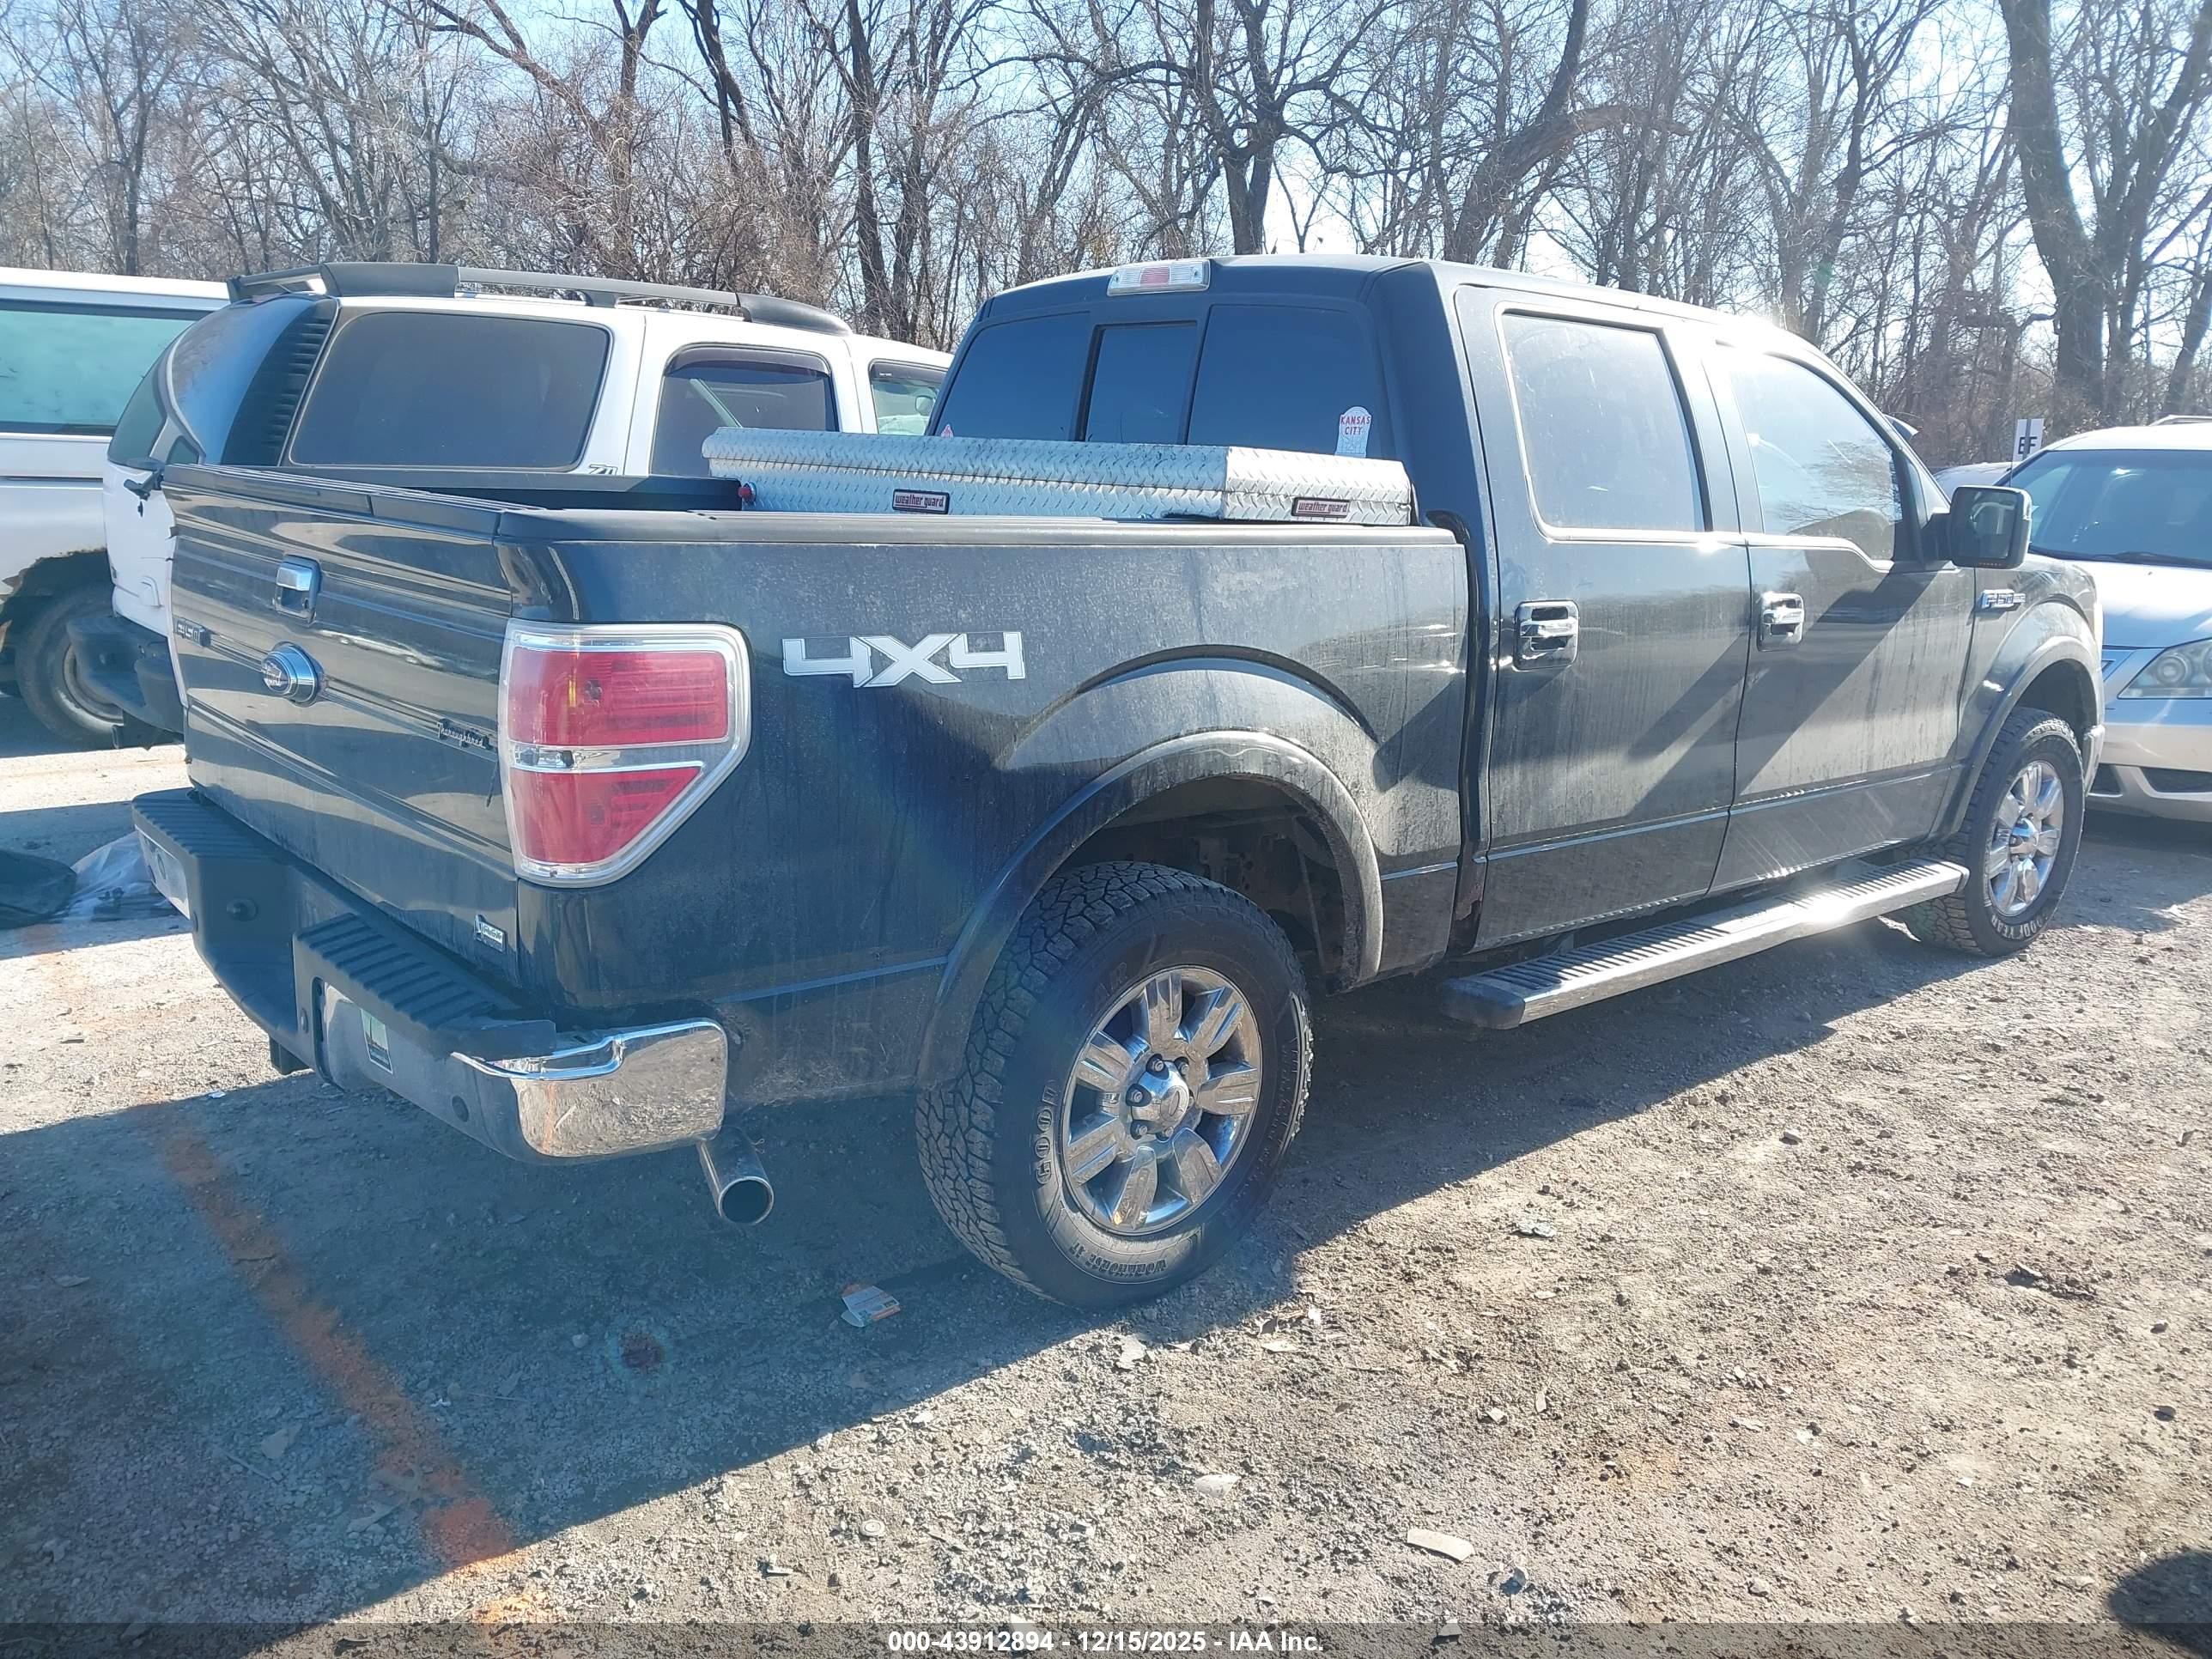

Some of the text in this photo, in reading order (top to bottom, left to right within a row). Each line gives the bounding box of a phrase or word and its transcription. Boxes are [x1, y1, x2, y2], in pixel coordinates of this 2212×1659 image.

[1340, 416, 1371, 424] KANSAS
[1345, 426, 1363, 435] CITY
[896, 494, 945, 508] weather guard
[1298, 501, 1348, 514] weather guard
[782, 632, 1025, 688] 4X4
